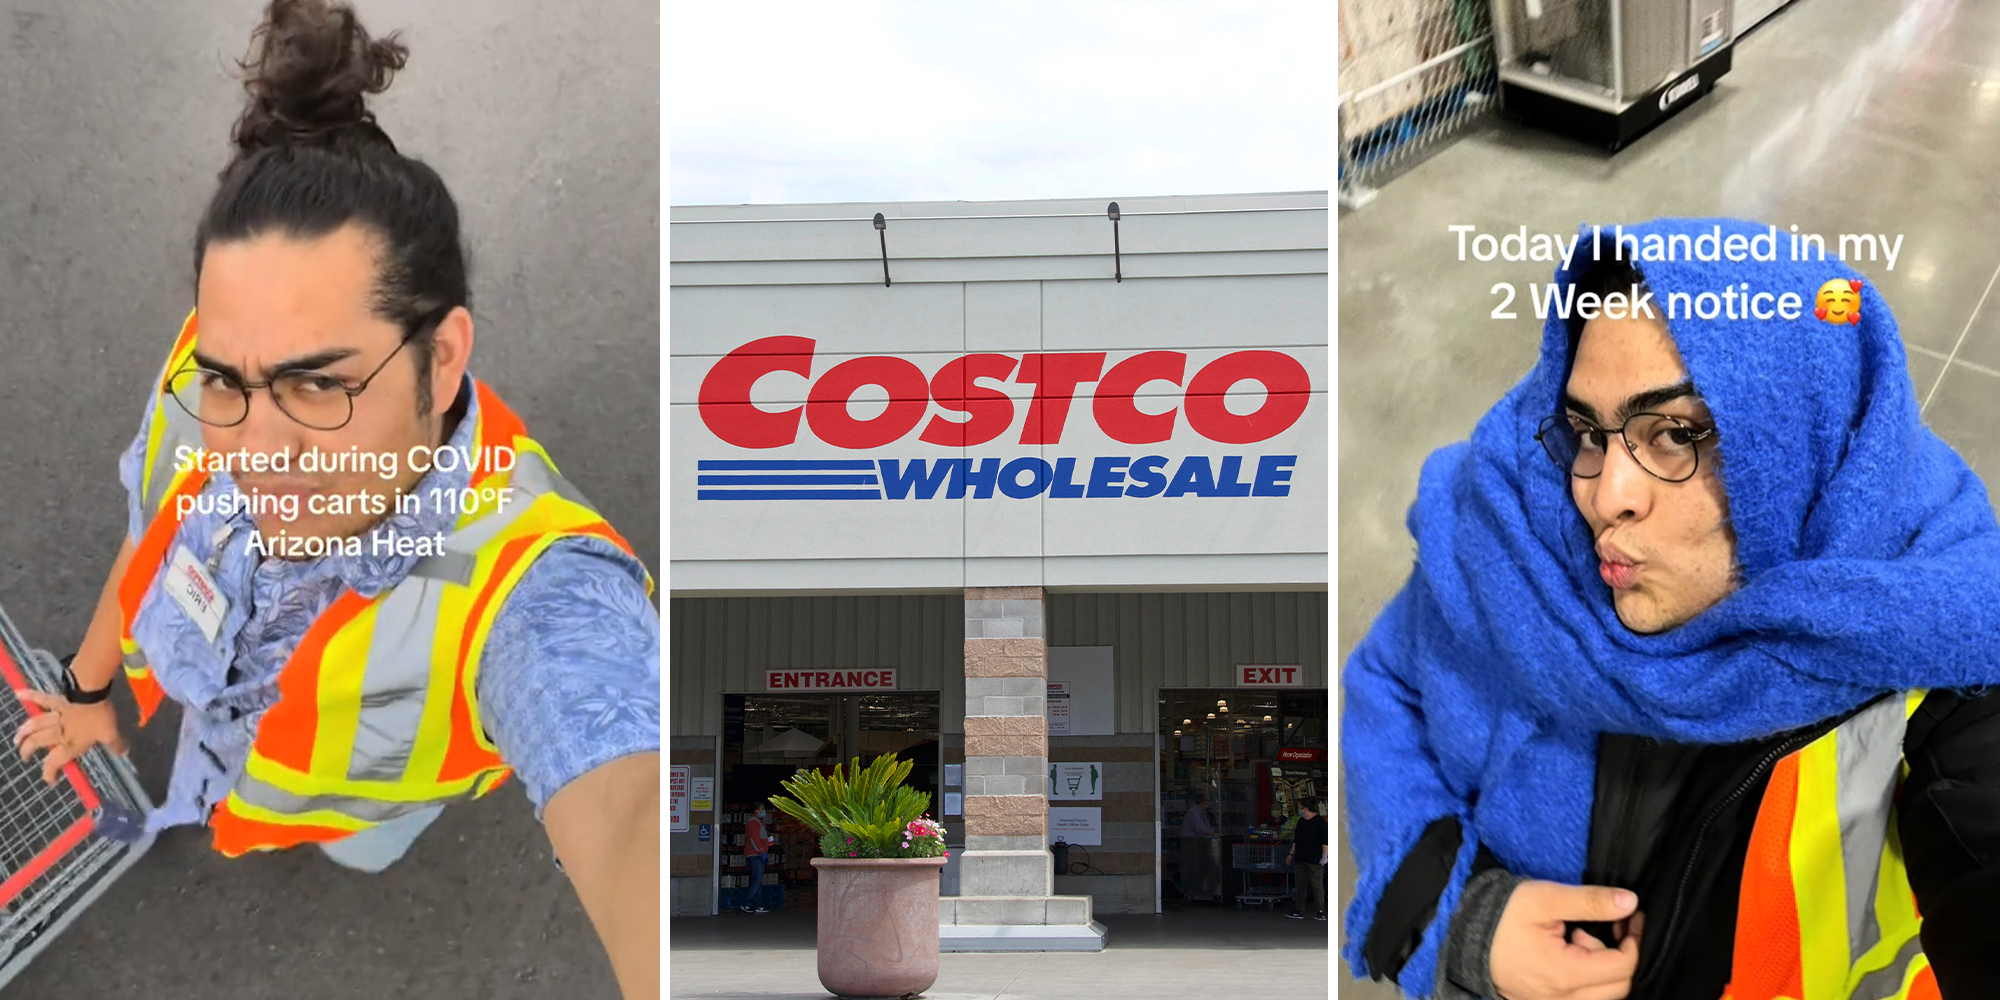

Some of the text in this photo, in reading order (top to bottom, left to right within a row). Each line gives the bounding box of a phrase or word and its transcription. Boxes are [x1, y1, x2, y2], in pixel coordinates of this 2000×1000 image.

[697, 335, 1312, 450] COSTCO
[877, 454, 1298, 500] WHOLESALE
[769, 671, 893, 688] ENTRANCE
[1243, 667, 1297, 684] EXIT
